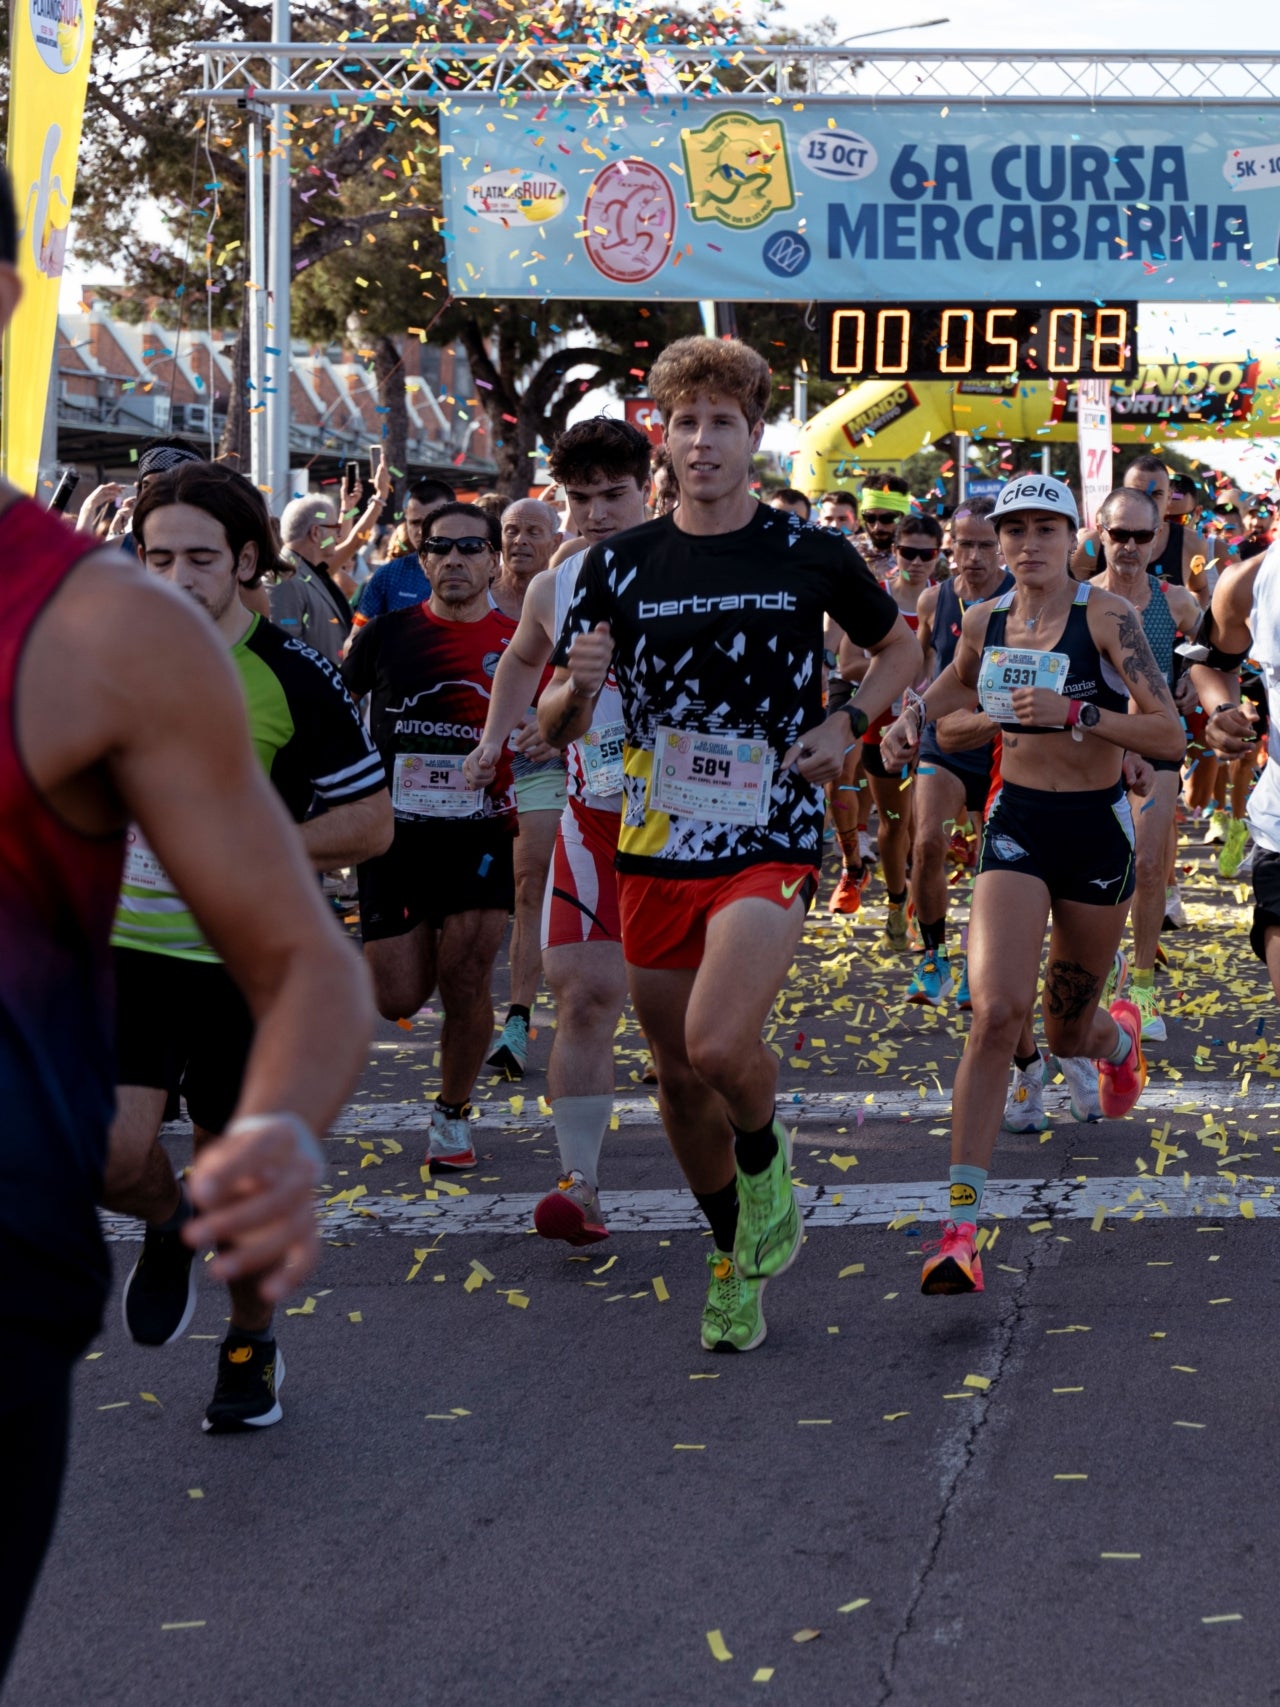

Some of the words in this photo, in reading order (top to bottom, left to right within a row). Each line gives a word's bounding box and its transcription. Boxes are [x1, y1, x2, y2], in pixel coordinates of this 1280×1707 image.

[807, 140, 827, 160] 13
[832, 145, 868, 168] OCT
[890, 144, 972, 201] 6A
[991, 144, 1189, 202] CURSA
[1236, 160, 1257, 178] 5K
[522, 181, 557, 200] RUIZ
[827, 203, 1252, 261] MERCABARNA
[830, 308, 910, 374] 00
[1110, 363, 1243, 396] UNDO
[847, 388, 908, 434] MUNDO
[1067, 395, 1201, 414] DORTIVO
[1003, 483, 1060, 505] ciele
[638, 591, 797, 619] bertrandt
[1002, 667, 1037, 686] 6331
[430, 770, 449, 785] 24
[691, 755, 731, 778] 584
